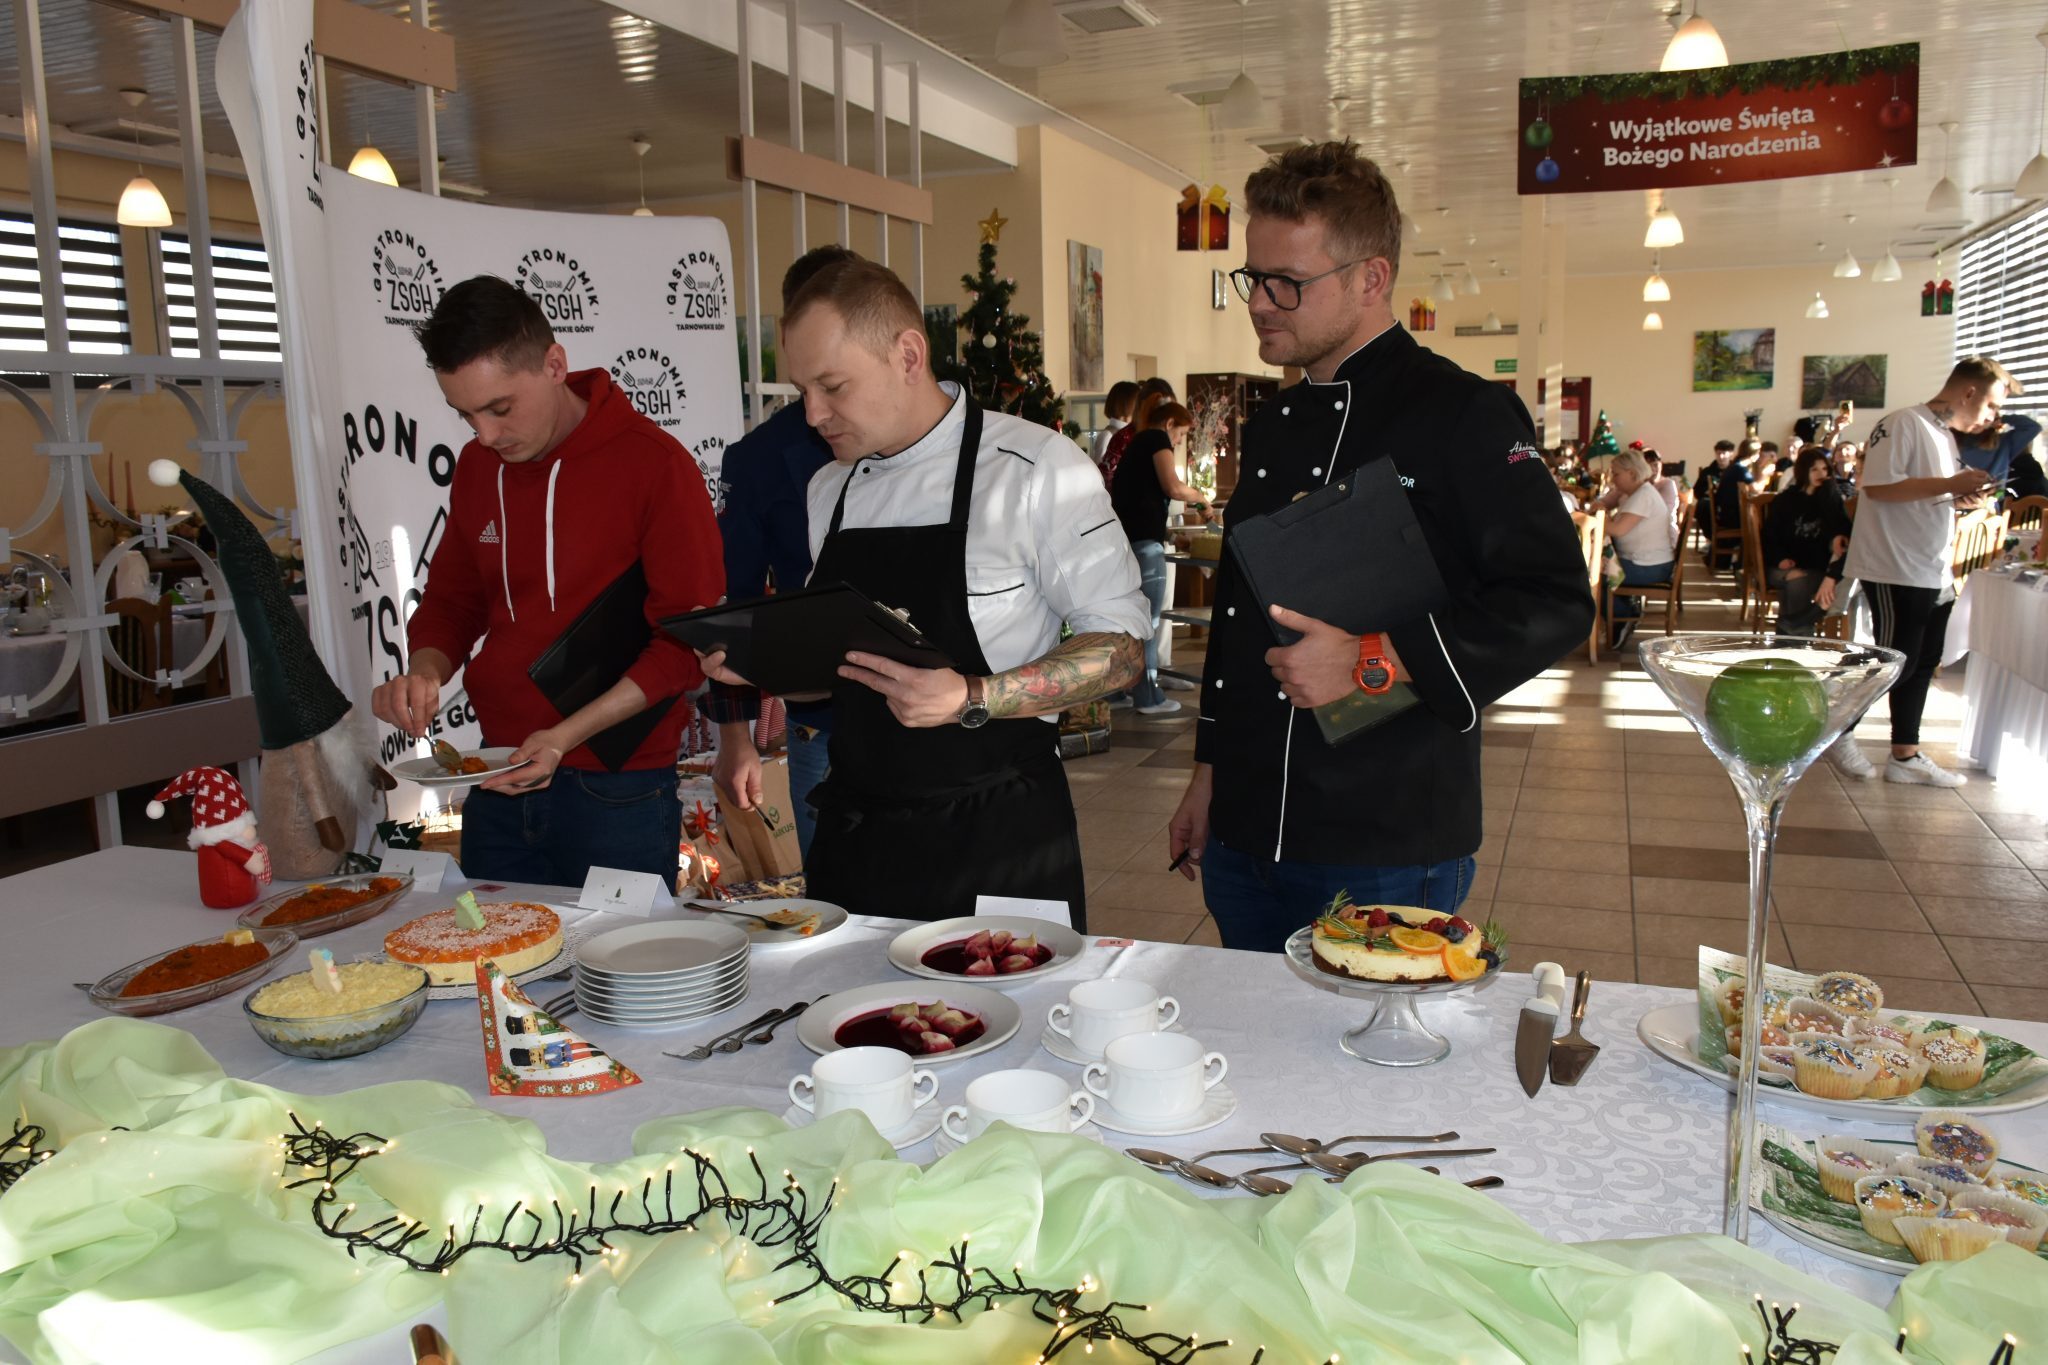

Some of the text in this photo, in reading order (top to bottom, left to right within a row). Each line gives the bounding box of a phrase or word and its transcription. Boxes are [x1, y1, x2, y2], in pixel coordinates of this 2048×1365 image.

[1610, 106, 1815, 143] Wyjątkowe Święta
[1603, 130, 1821, 168] Bożego Narodzenia
[514, 248, 599, 306] ASTRONOMIK
[387, 279, 433, 313] ZSGH
[683, 293, 721, 319] ZSGH
[611, 347, 686, 400] STRONOMIK
[479, 535, 500, 544] adidas
